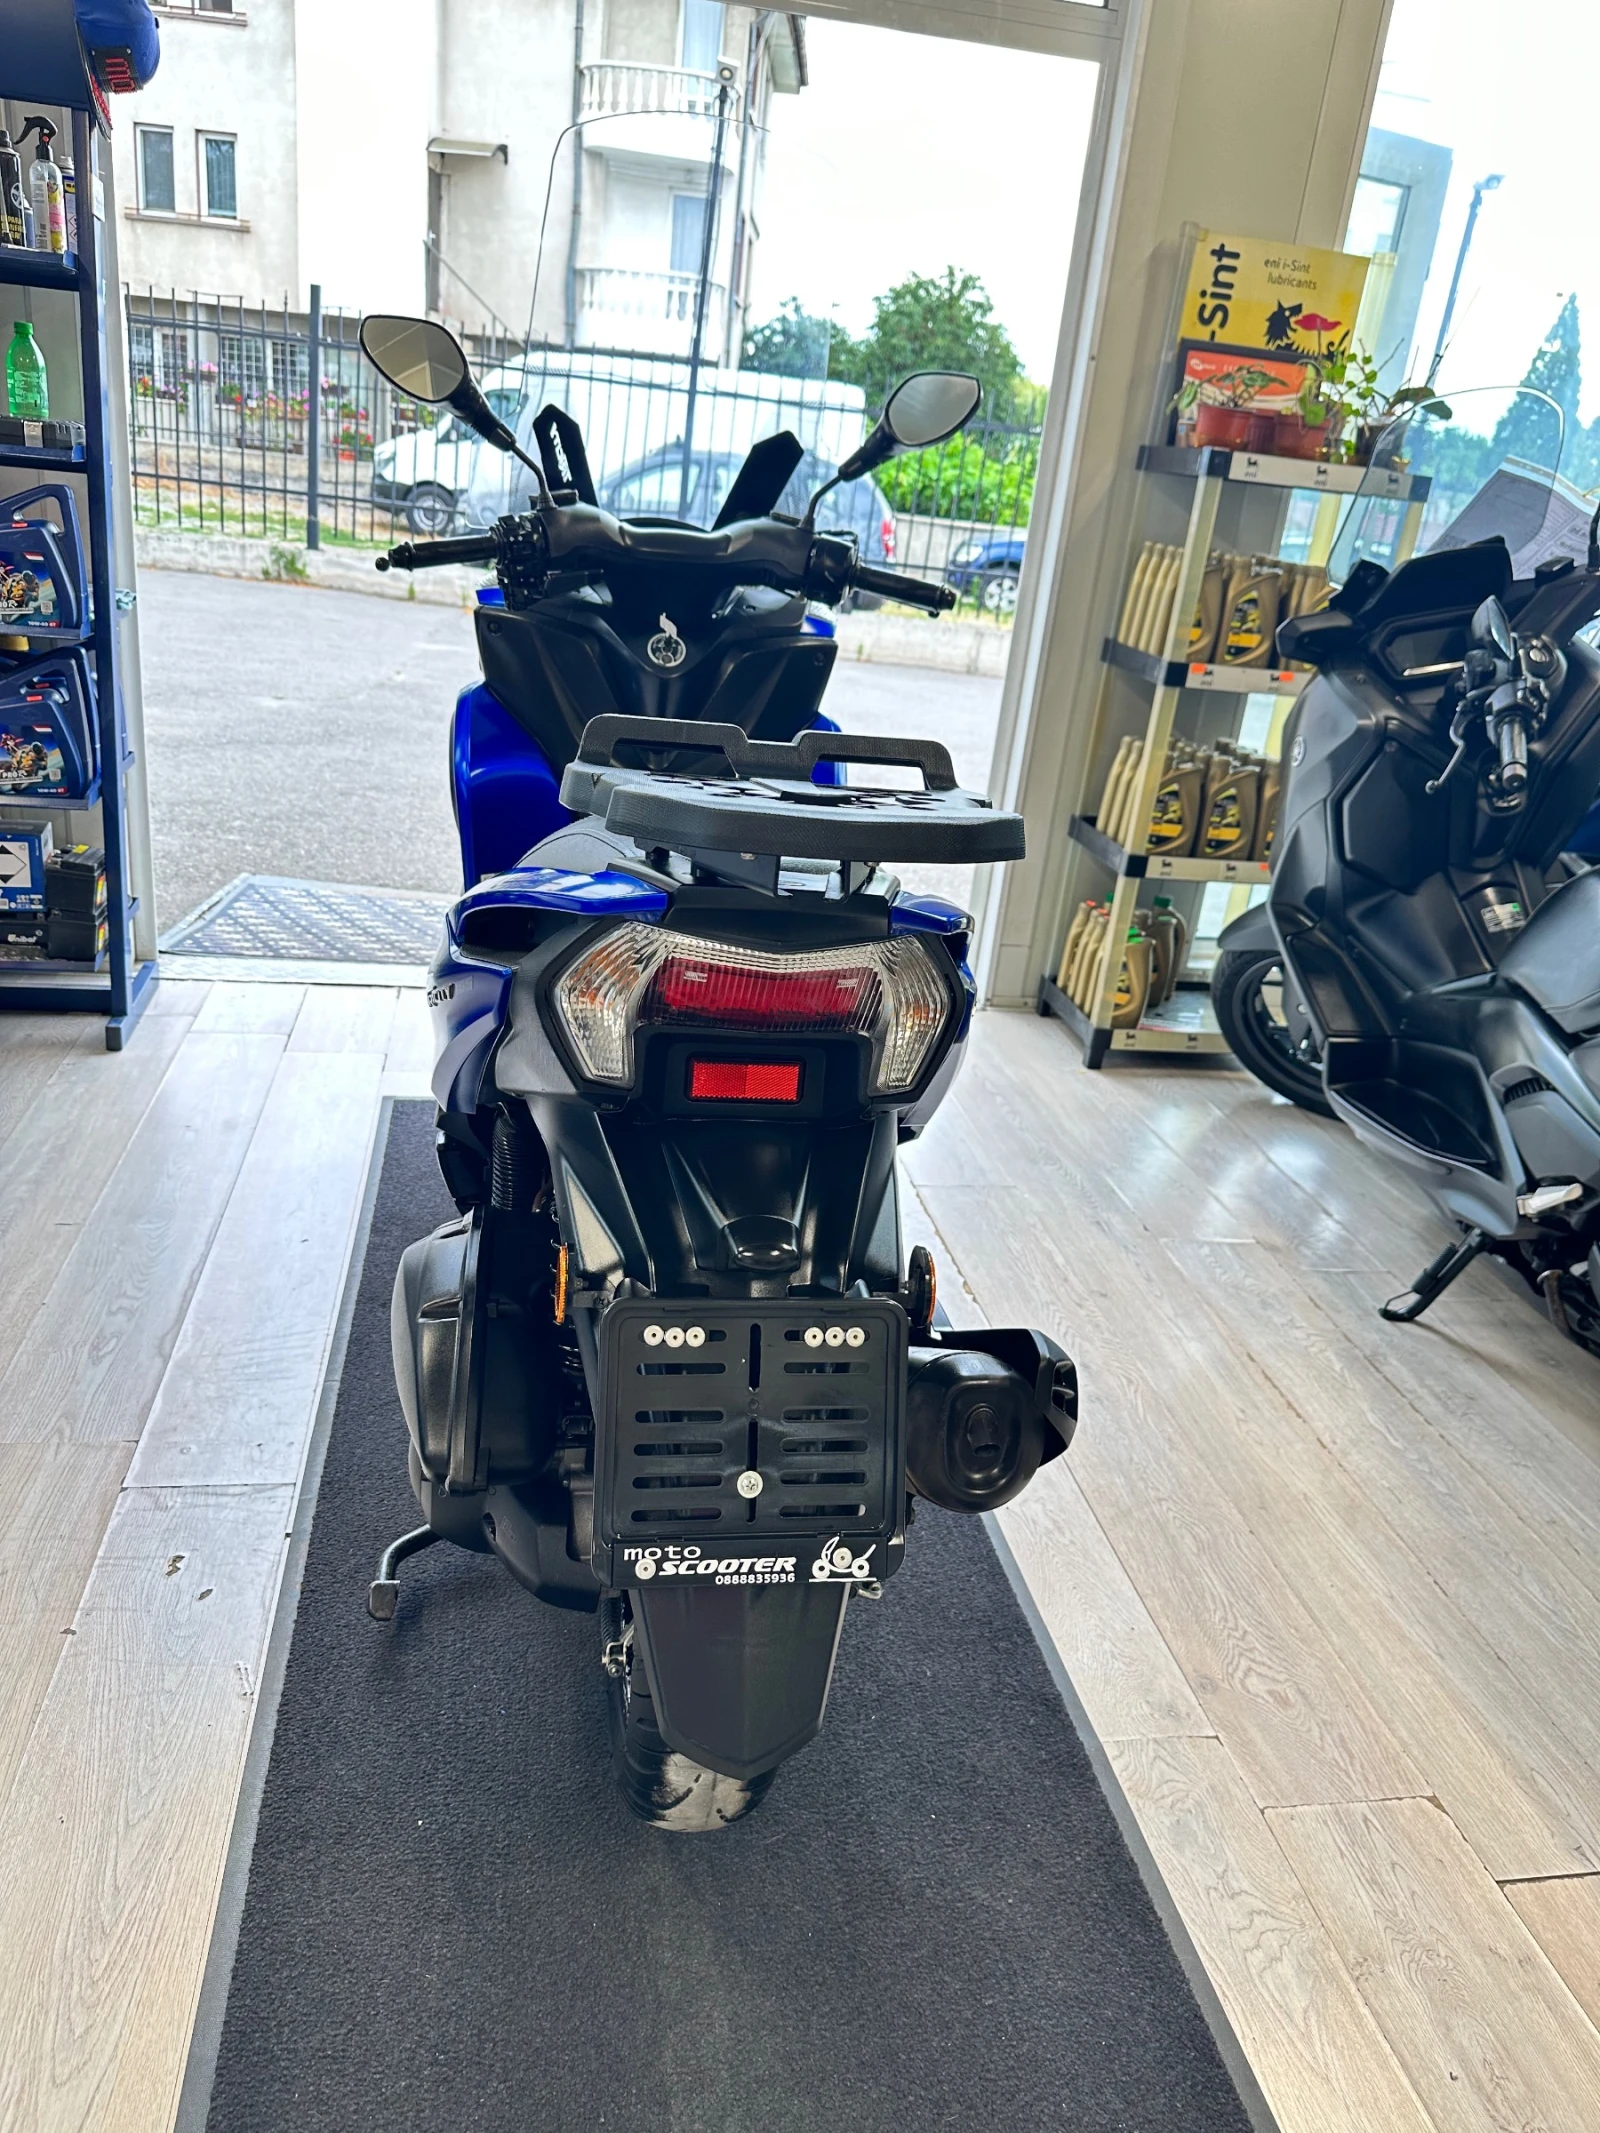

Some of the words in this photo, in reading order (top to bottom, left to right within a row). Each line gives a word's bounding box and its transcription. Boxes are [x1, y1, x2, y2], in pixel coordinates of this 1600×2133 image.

[1264, 257, 1281, 269] eni
[1282, 258, 1311, 274] i-Sint
[1267, 272, 1318, 291] lubricants
[624, 1545, 701, 1560] moto
[659, 1557, 797, 1576] SCOOTER
[715, 1573, 796, 1585] 0888835936
